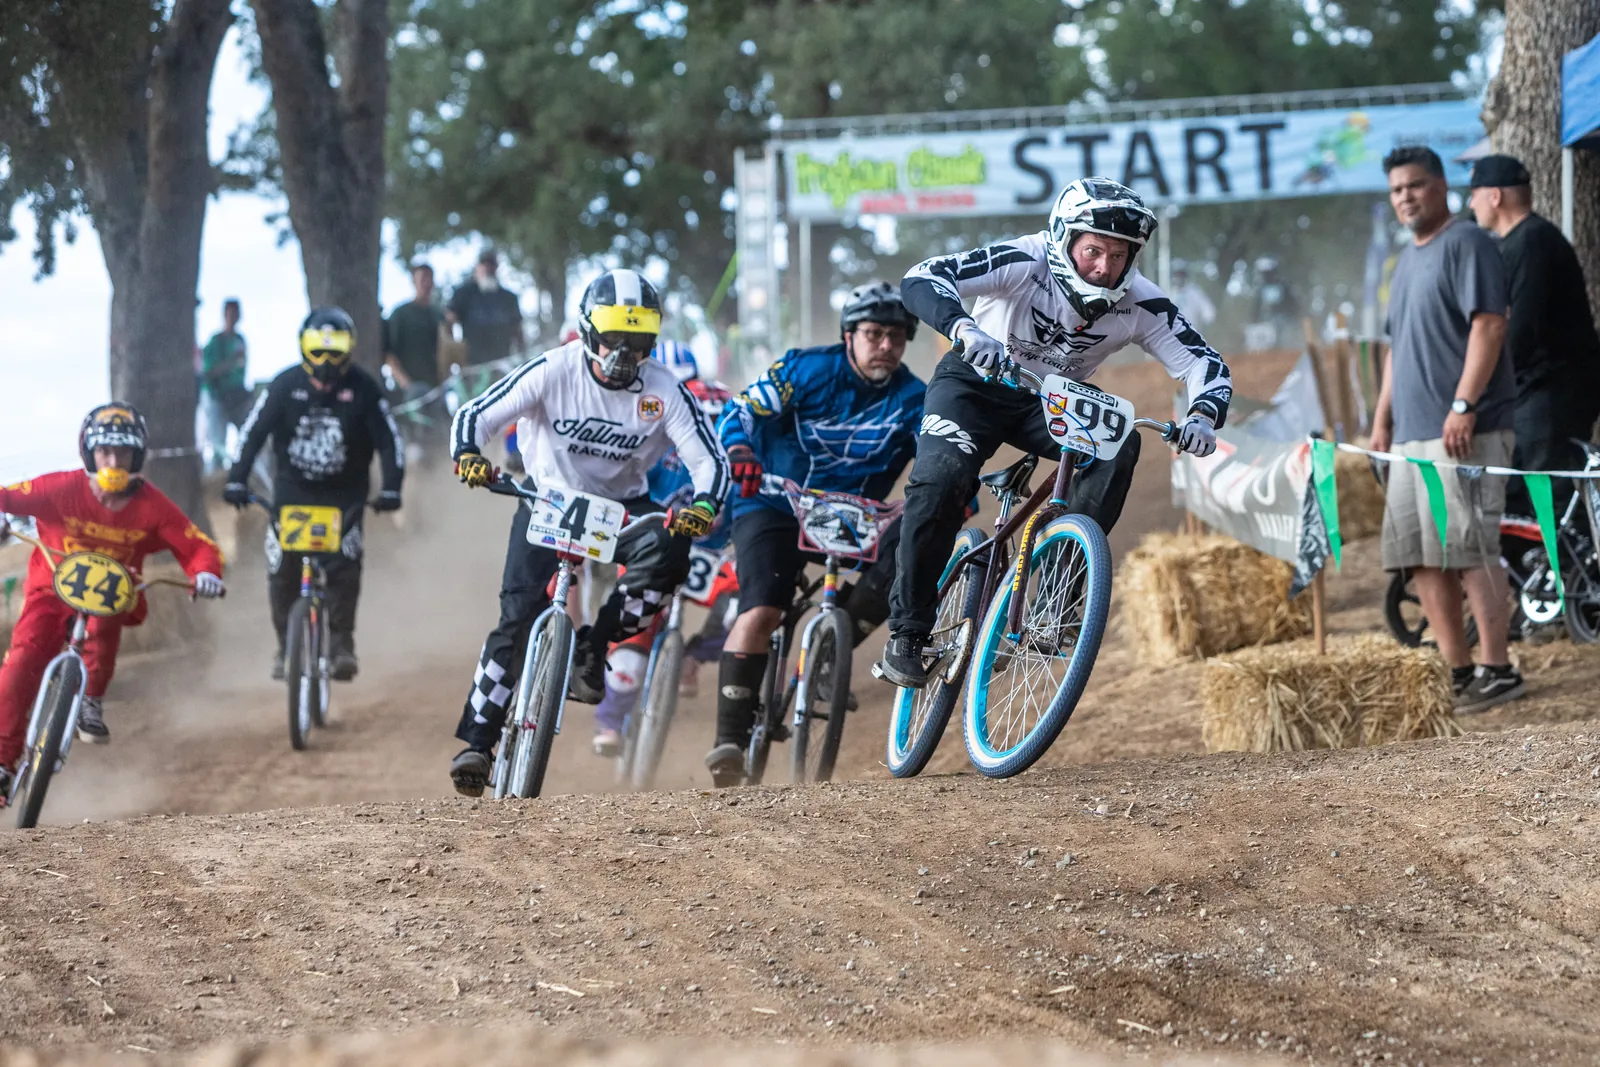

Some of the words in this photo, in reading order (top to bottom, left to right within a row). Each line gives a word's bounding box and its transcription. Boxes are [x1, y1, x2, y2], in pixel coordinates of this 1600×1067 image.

[1012, 122, 1286, 205] START
[1074, 398, 1127, 442] 99
[566, 443, 633, 462] RACING
[559, 494, 591, 541] 4
[60, 563, 123, 612] 44
